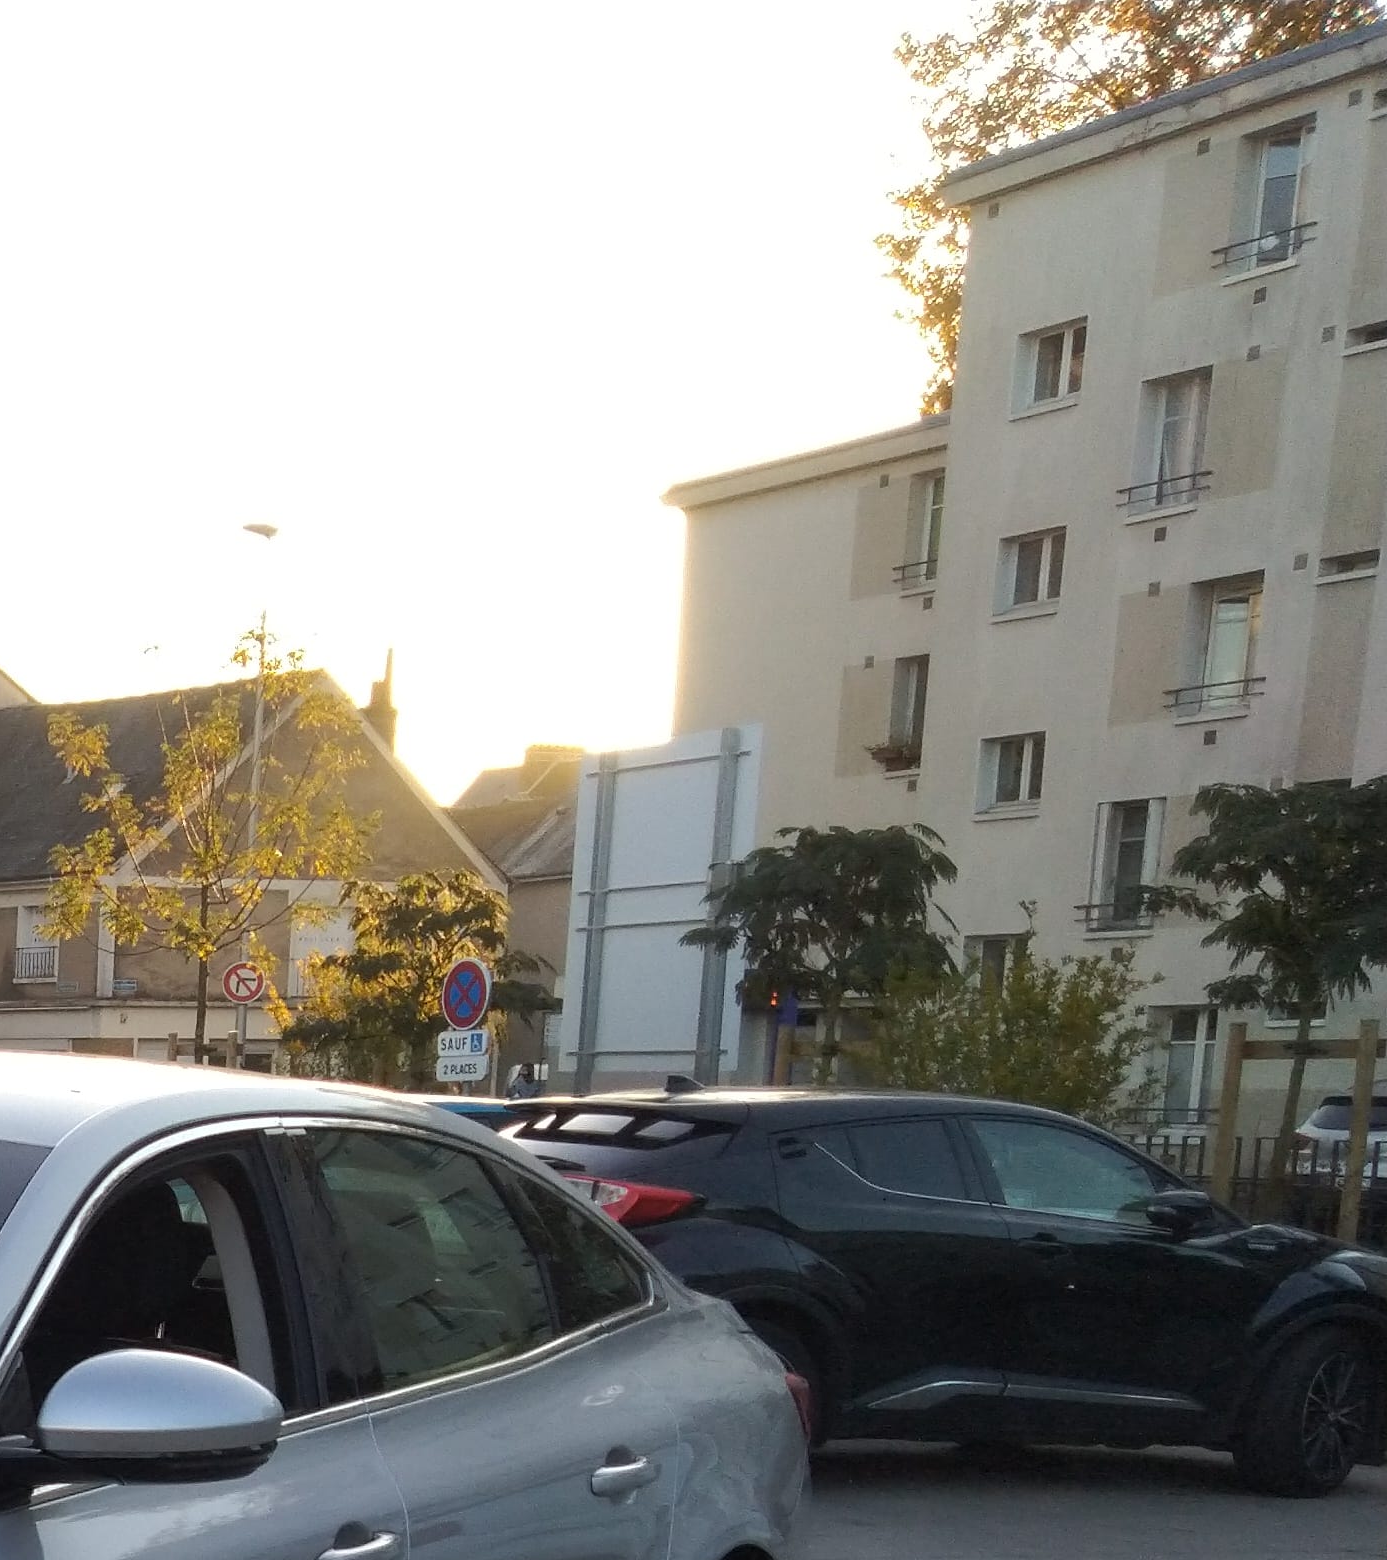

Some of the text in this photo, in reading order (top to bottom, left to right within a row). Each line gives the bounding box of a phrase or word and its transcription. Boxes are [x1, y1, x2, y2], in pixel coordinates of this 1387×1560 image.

[440, 1037, 468, 1051] SAUF
[443, 1062, 477, 1076] 2 PLACES
